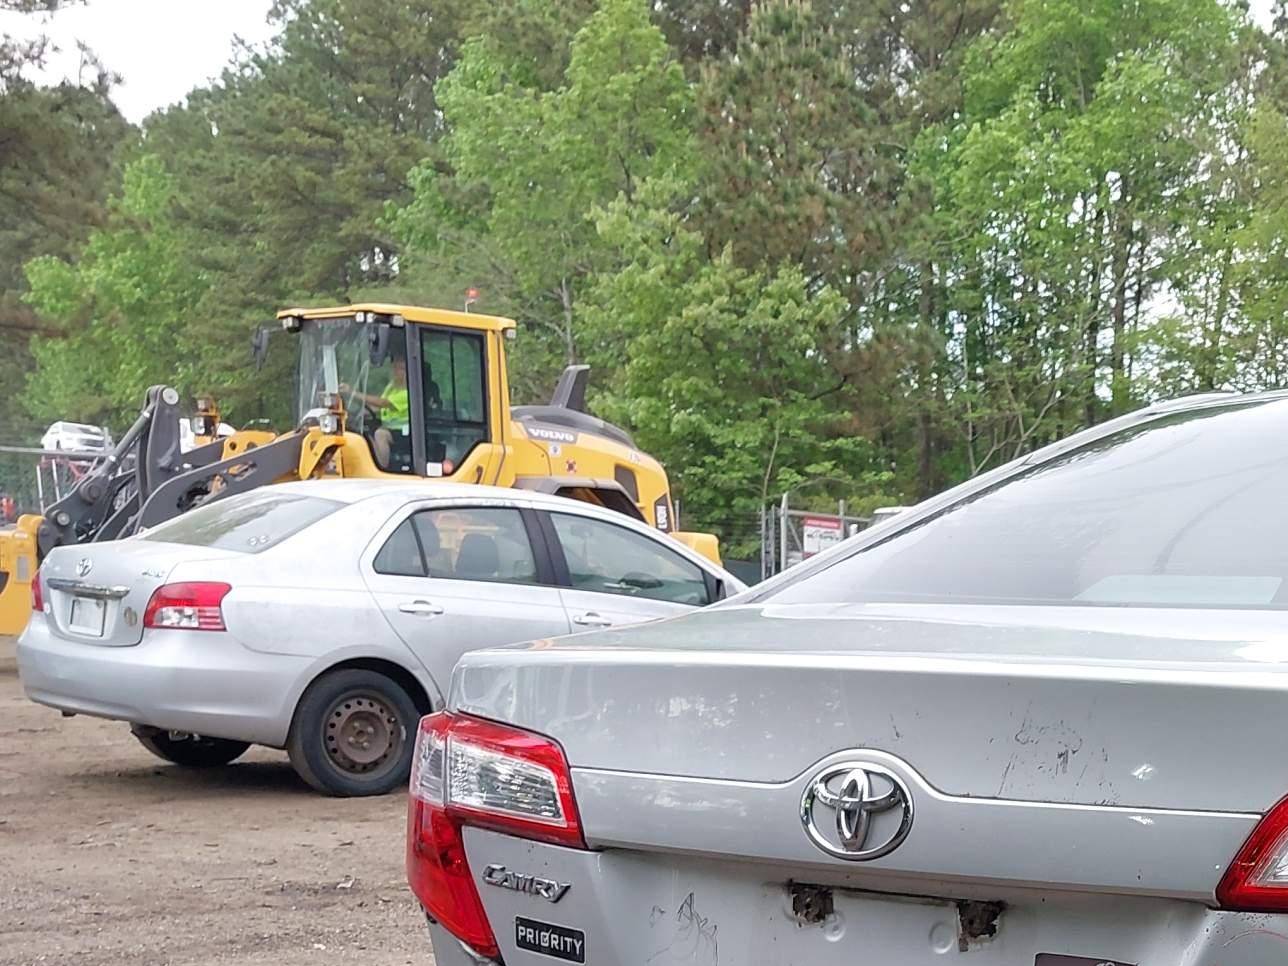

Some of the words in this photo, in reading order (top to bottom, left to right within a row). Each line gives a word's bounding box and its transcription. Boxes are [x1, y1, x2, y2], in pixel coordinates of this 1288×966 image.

[528, 428, 575, 442] VOLVO
[482, 864, 571, 904] CAMRY
[517, 926, 583, 956] PRIORITY
